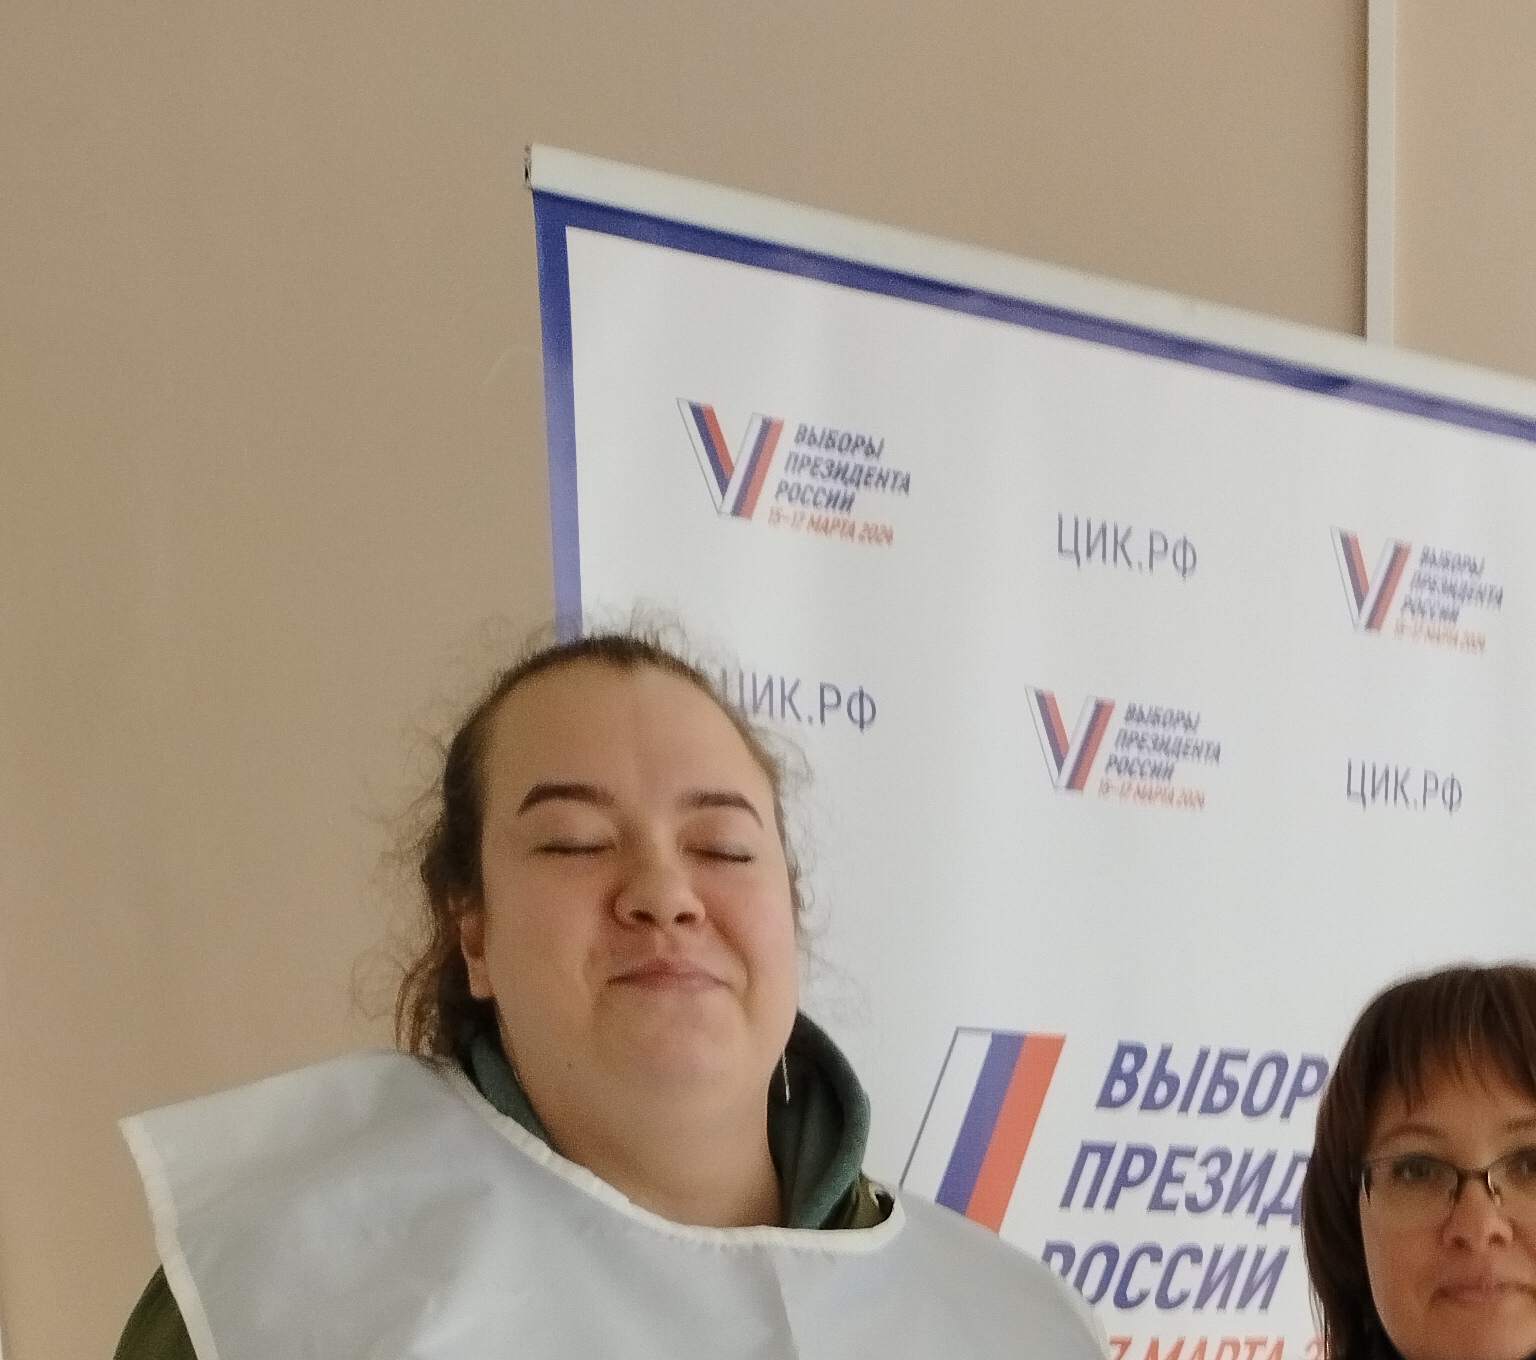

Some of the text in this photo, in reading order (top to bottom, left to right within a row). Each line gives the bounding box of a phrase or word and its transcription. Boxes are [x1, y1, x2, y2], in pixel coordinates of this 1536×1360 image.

[793, 422, 885, 461] ВЫБОРЫ
[784, 451, 910, 496] ПРЕЗИДЕНТА
[774, 479, 856, 514] РОССИИ
[1057, 511, 1198, 583] ЦИК.РФ
[1420, 545, 1486, 578] ВЫБОРЫ
[1400, 593, 1460, 626] РОССИИ
[1410, 570, 1503, 611] ПРЕЗИДЕНТА
[721, 667, 877, 733] ЦИК.РФ
[1124, 702, 1200, 735] ВЫБОРЫ
[1114, 728, 1221, 765] ПРЕЗИДЕНТА
[1105, 753, 1175, 782] РОССИИ
[1346, 757, 1463, 816] ЦИК.РФ
[1096, 1040, 1330, 1122] ВЫБОР
